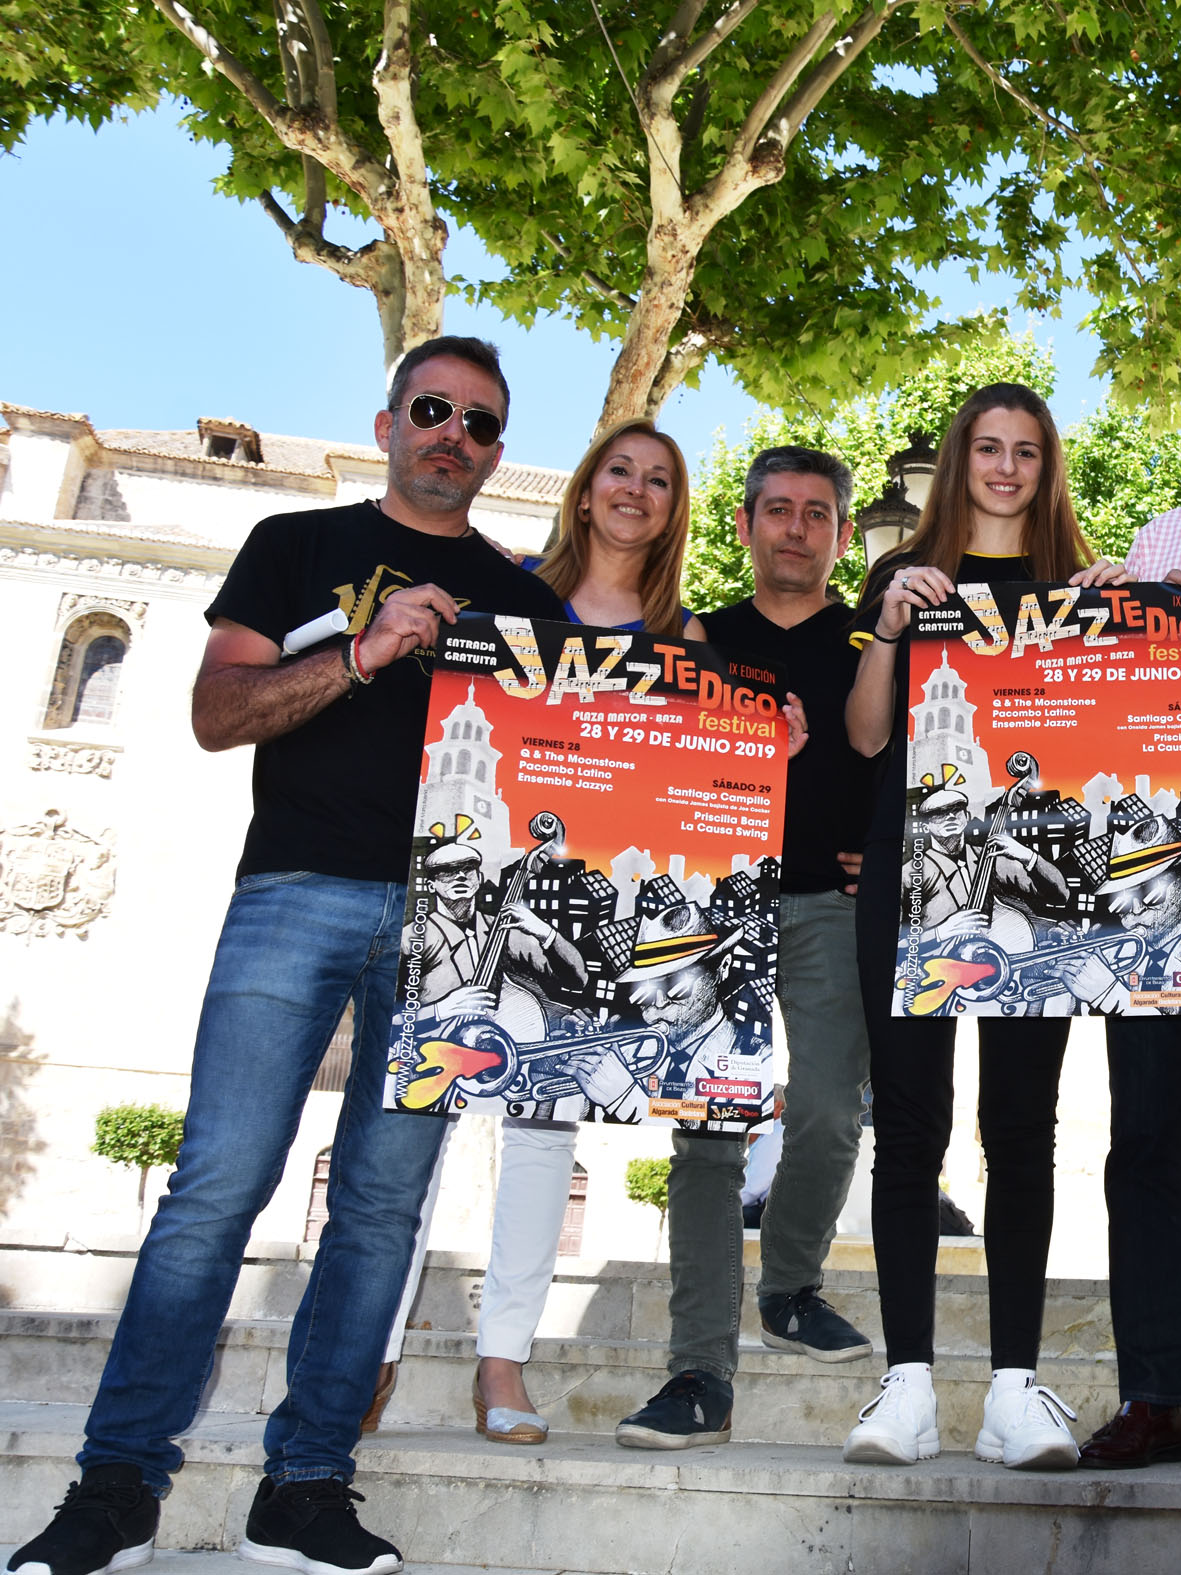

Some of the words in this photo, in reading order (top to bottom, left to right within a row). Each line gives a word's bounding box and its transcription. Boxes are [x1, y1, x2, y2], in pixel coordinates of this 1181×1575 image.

[1172, 595, 1181, 608] IX
[918, 610, 962, 620] ENTRADA
[958, 583, 1119, 658] JAZZ
[1100, 590, 1144, 627] TE
[918, 622, 964, 632] GRATUITA
[446, 637, 496, 652] ENTRADA
[414, 648, 436, 658] ESTI
[444, 651, 498, 666] GRATUITA
[1035, 658, 1064, 669] PLAZA
[1066, 653, 1103, 666] MAYOR
[1110, 650, 1135, 660] BAZA
[493, 614, 667, 706] JAZZ
[653, 643, 697, 691] TE
[700, 670, 777, 718] DIGO
[728, 662, 738, 676] IX
[740, 664, 776, 685] EDICIÓN
[1043, 667, 1064, 682] 28
[1067, 668, 1078, 682] Y
[1082, 668, 1102, 682] 29
[1106, 668, 1126, 681] DE
[1130, 666, 1181, 681] JUNIO
[993, 688, 1032, 697] VIERNES
[1034, 688, 1046, 696] 28
[992, 698, 1002, 708] Q
[1004, 698, 1012, 708] &
[1014, 698, 1032, 707] The
[1034, 698, 1096, 707] Moonstones
[572, 710, 605, 722] PLAZA
[607, 712, 648, 722] MAYOR
[655, 713, 683, 724] BAZA
[992, 708, 1042, 718] Pacombo
[1044, 708, 1076, 717] Latino
[1127, 714, 1174, 724] Santiago
[698, 711, 775, 738] festival
[992, 719, 1042, 728] Ensemble
[1043, 719, 1078, 728] Jazzyc
[522, 736, 565, 750] VIERNES
[567, 742, 581, 752] 28
[580, 722, 602, 739] 28
[607, 725, 619, 740] Y
[622, 727, 645, 744] 29
[648, 730, 672, 747] DE
[674, 734, 731, 754] JUNIO
[734, 740, 776, 759] 2019
[1142, 743, 1155, 752] La
[520, 748, 531, 758] Q
[532, 749, 542, 759] &
[544, 751, 565, 762] The
[567, 753, 636, 770] Moonstones
[518, 760, 575, 775] Pacombo
[577, 766, 613, 780] Latino
[517, 772, 573, 787] Ensemble
[575, 778, 614, 792] Jazzyc
[712, 778, 756, 792] SÁBADO
[759, 784, 772, 794] 29
[667, 786, 718, 802] Santiago
[720, 792, 771, 806] Campillo
[694, 810, 738, 825] Priscilla
[740, 815, 770, 828] Band
[680, 820, 694, 831] La
[696, 822, 734, 836] Causa
[735, 826, 769, 841] Swing
[903, 838, 924, 1008] www.jazztedigofestival.com
[396, 898, 428, 1099] www.jazztedigofestival.com
[699, 1082, 759, 1095] Cruzcampo
